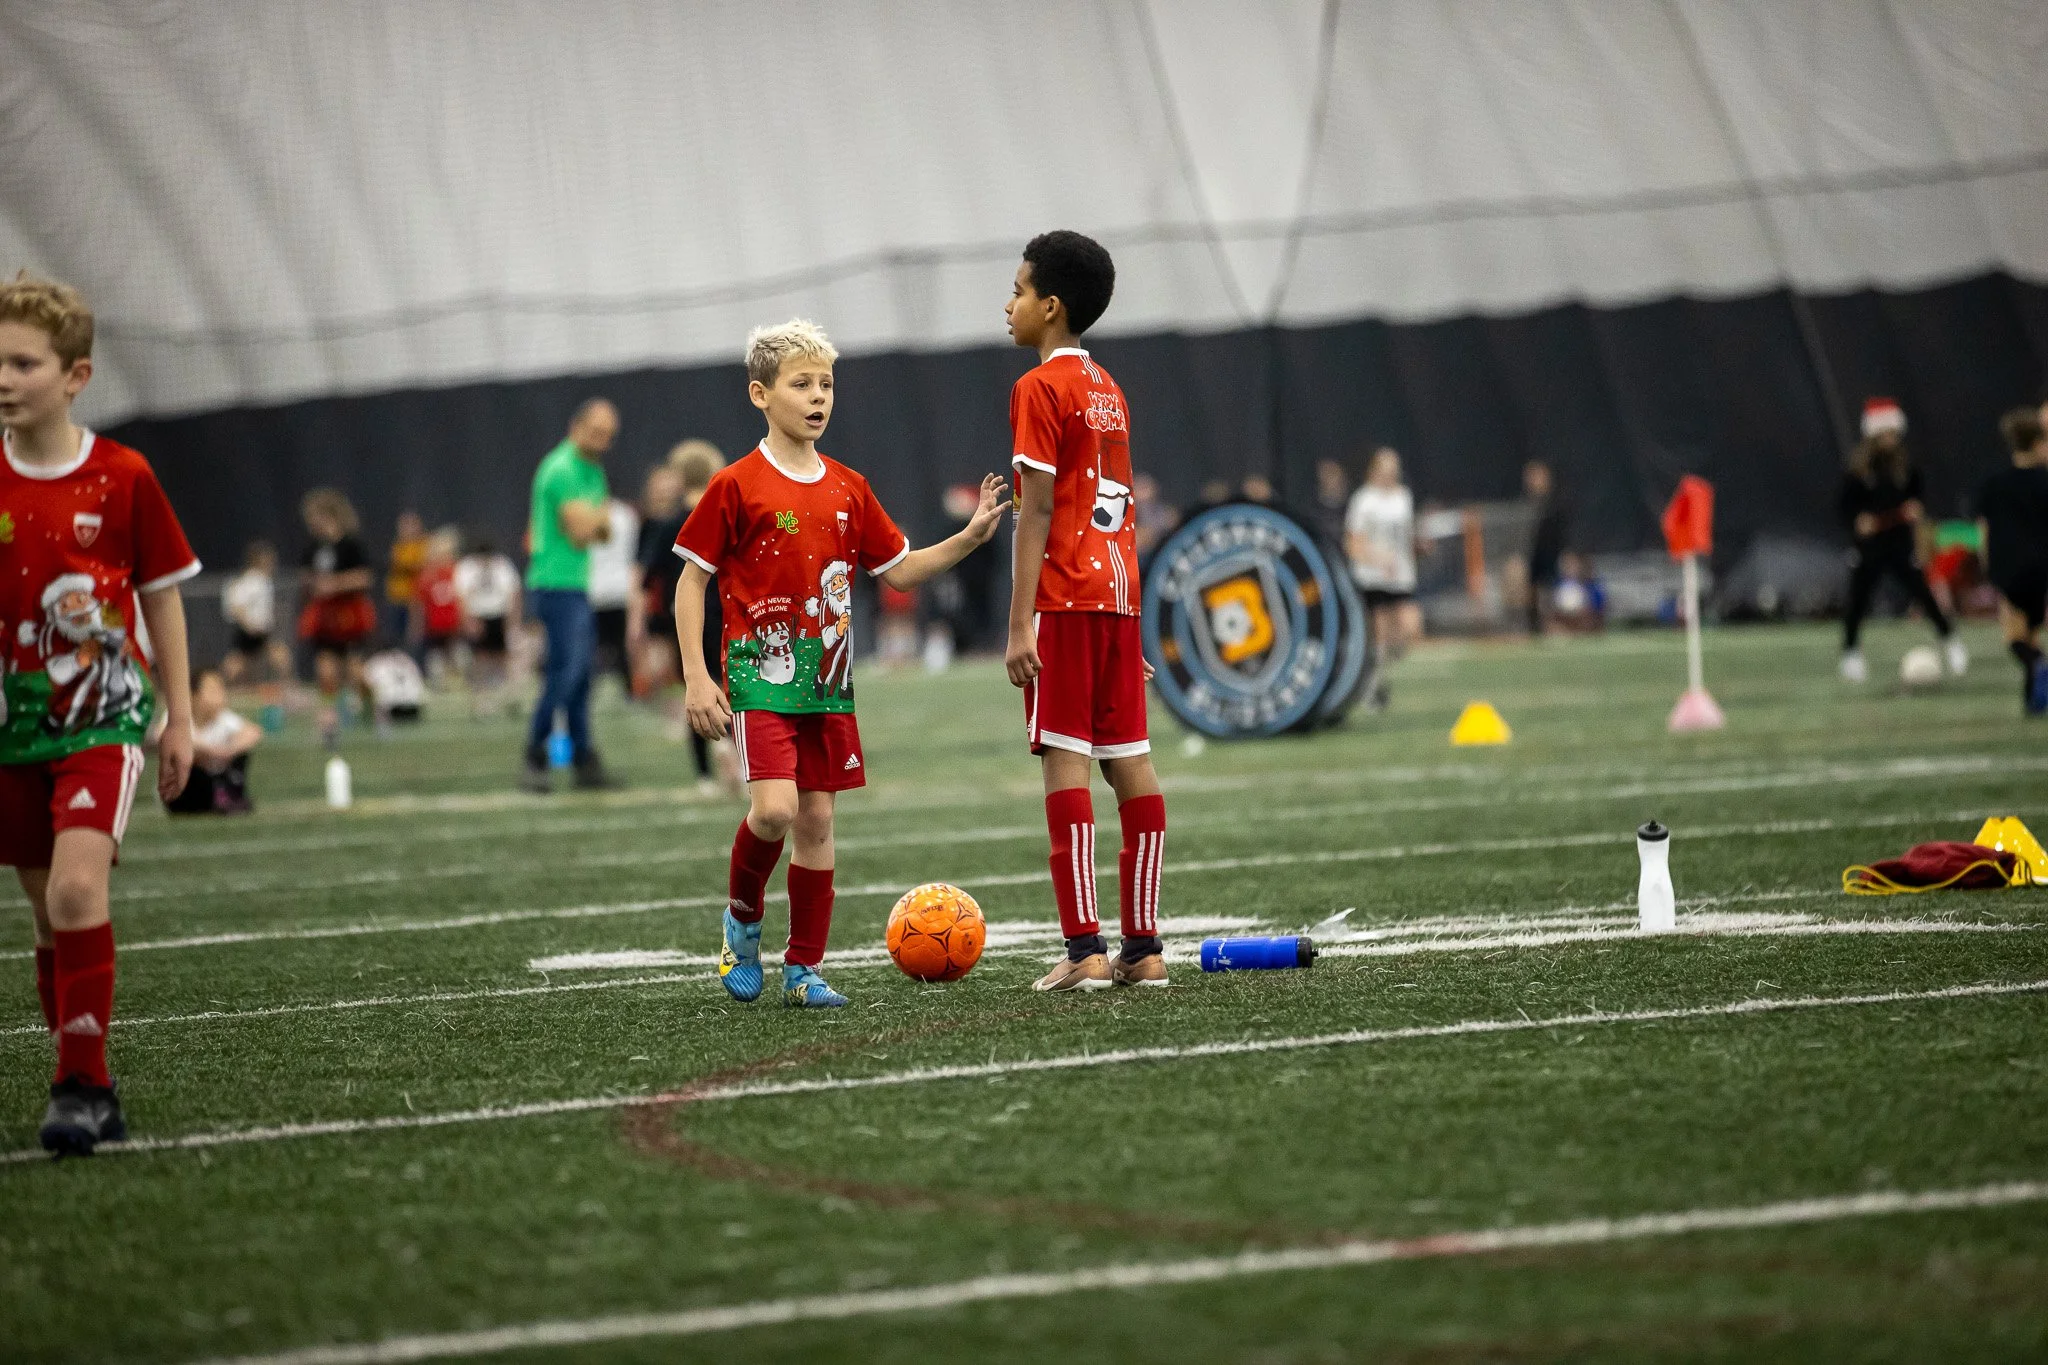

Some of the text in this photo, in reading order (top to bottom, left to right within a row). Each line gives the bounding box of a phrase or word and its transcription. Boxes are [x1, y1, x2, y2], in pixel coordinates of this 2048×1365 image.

[776, 511, 799, 534] MC
[767, 597, 792, 605] NEVER
[752, 608, 767, 620] WALK
